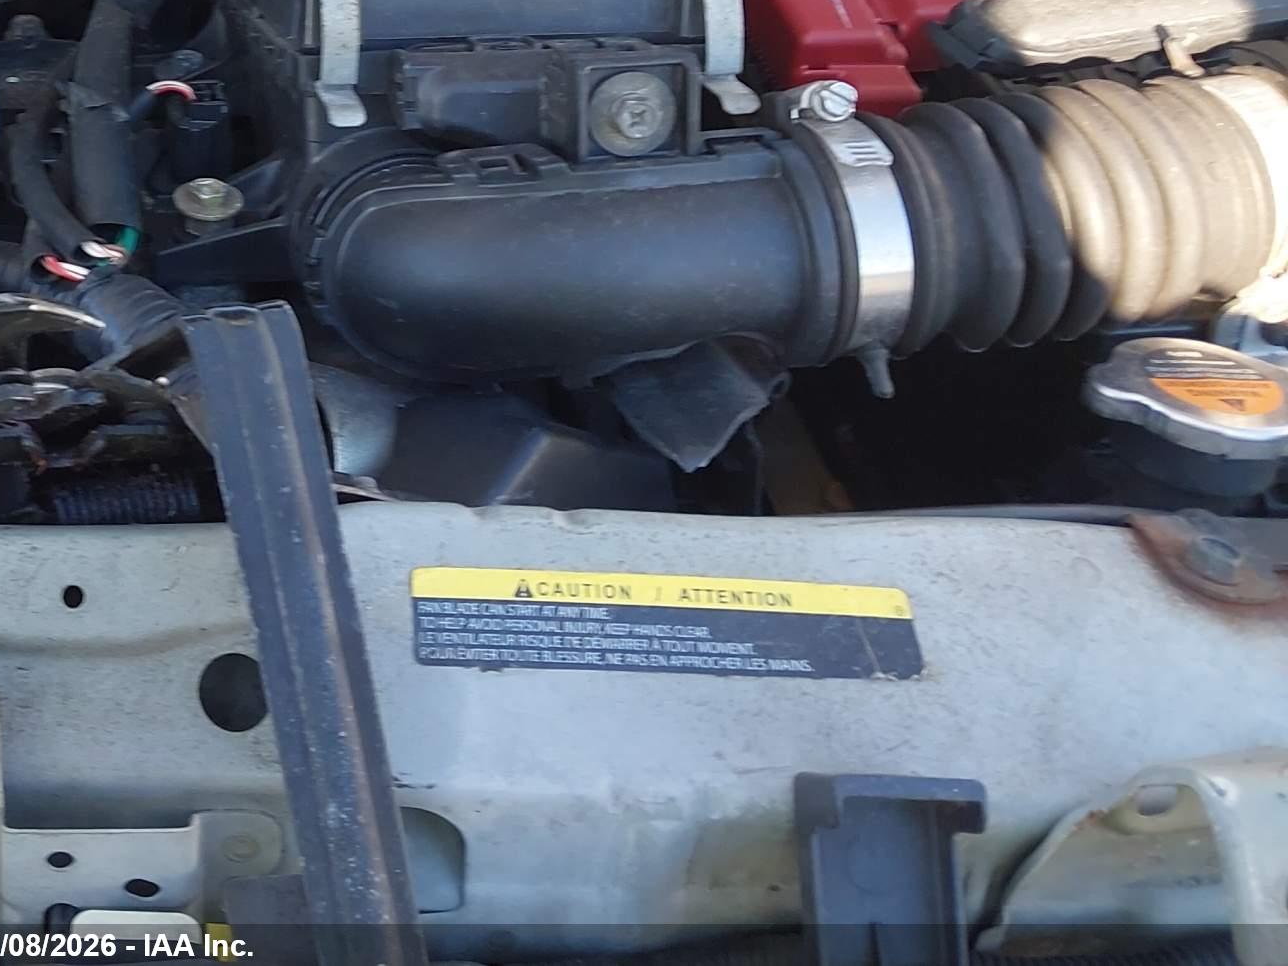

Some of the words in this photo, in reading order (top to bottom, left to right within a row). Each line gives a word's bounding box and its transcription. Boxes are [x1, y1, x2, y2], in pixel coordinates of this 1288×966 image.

[537, 581, 632, 600] CAUTION
[678, 587, 793, 607] ATTENTION
[662, 639, 695, 652] TOUT
